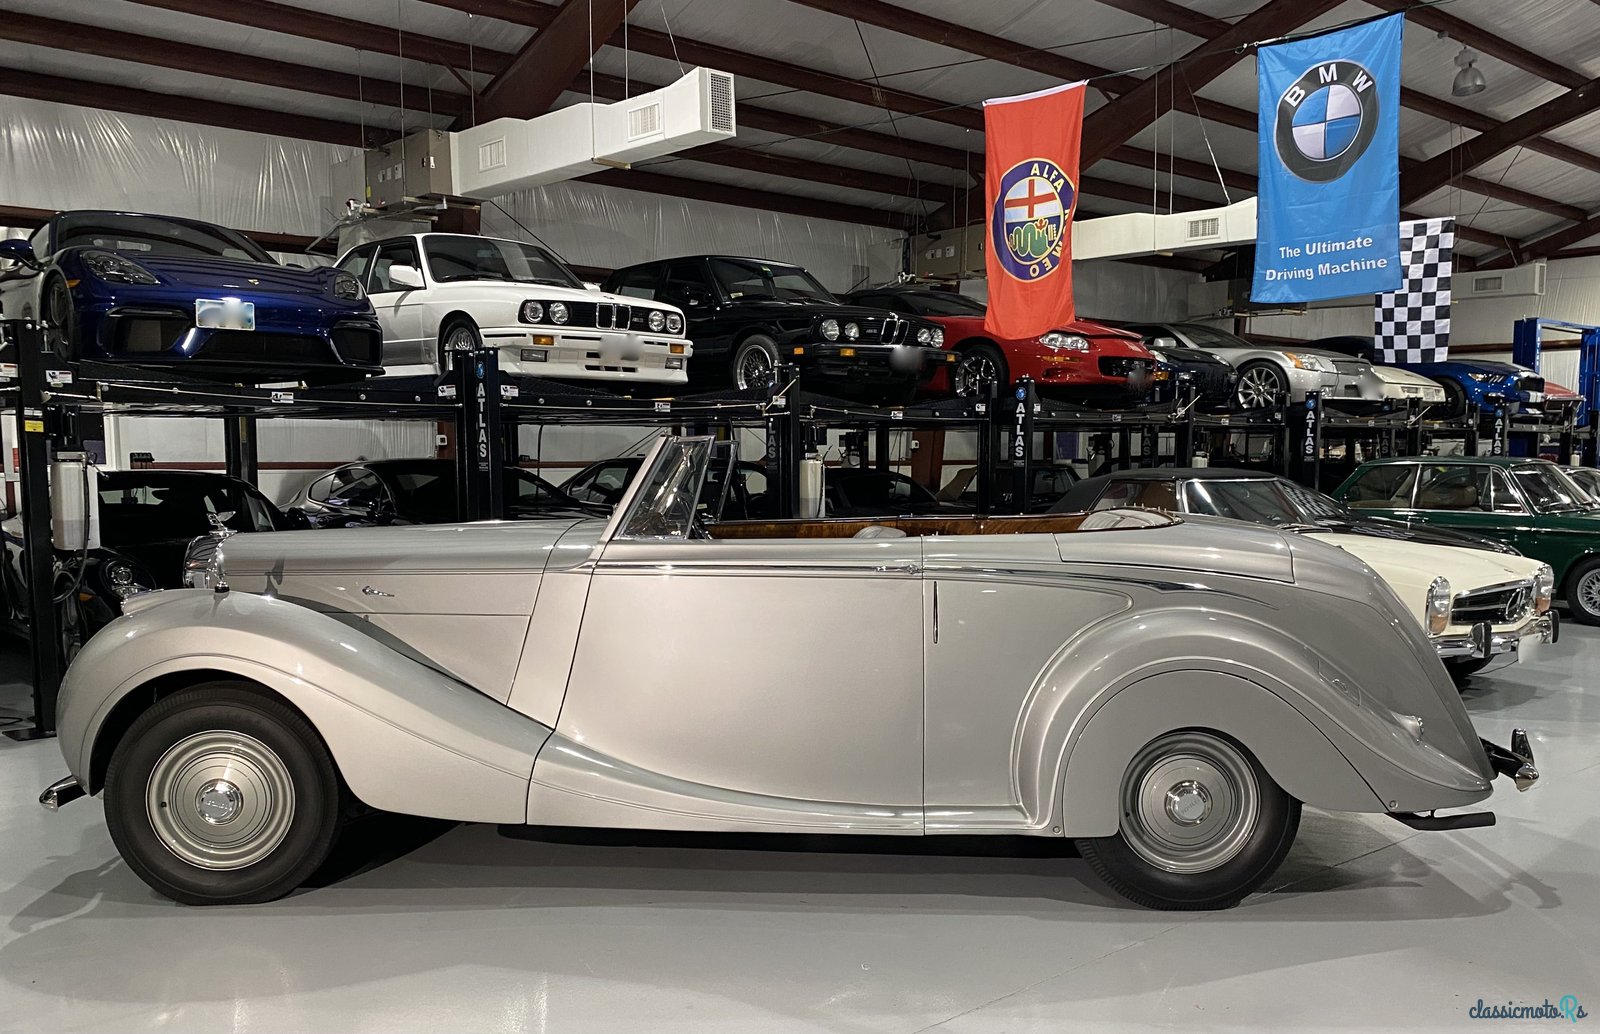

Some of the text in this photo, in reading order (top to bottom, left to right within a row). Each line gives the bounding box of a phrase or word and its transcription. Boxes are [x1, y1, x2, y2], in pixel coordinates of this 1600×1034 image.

[1284, 63, 1373, 107] BMW
[1030, 163, 1065, 193] ALFA
[1279, 236, 1373, 259] The Ultimate
[1265, 258, 1388, 281] Driving Machine
[477, 382, 487, 458] ATLAS
[1015, 402, 1025, 457] ATLAS
[1305, 410, 1315, 454] ATLAS
[1494, 418, 1503, 455] ATLAS
